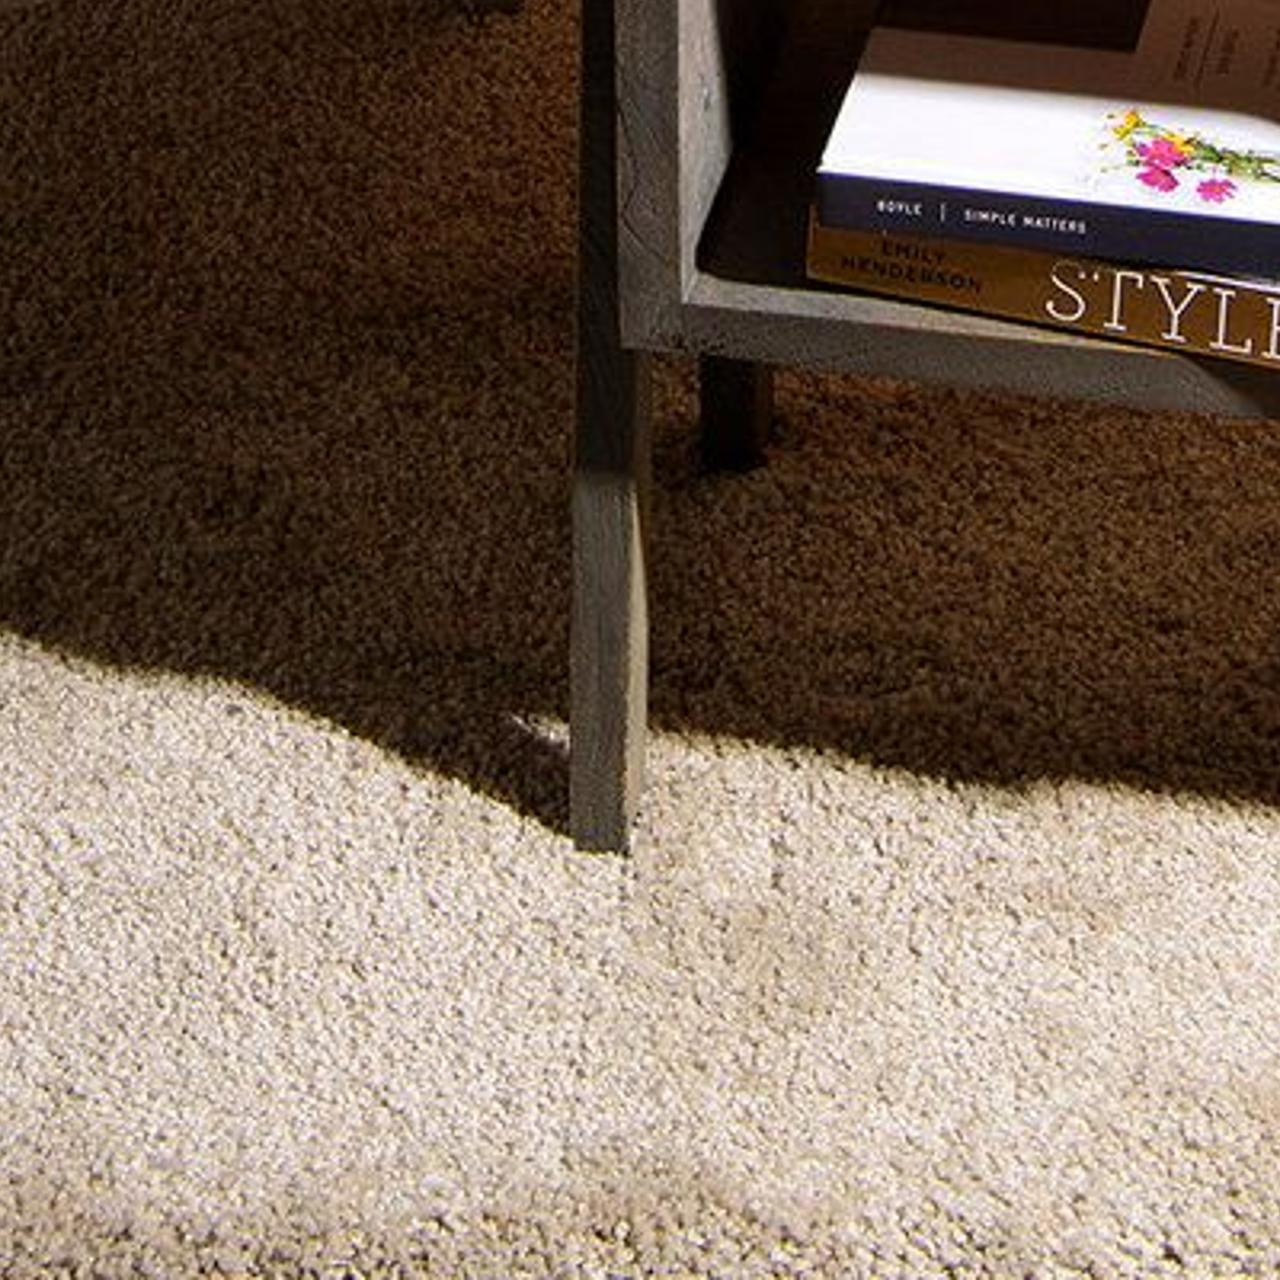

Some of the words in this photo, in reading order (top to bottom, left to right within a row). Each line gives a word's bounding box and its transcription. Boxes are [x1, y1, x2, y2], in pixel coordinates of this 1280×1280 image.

[875, 199, 924, 216] BOYLE
[963, 208, 1016, 228] SIMPLE
[1021, 215, 1088, 235] MATTERS
[881, 239, 946, 265] EMILY
[841, 256, 983, 292] HENDERSON
